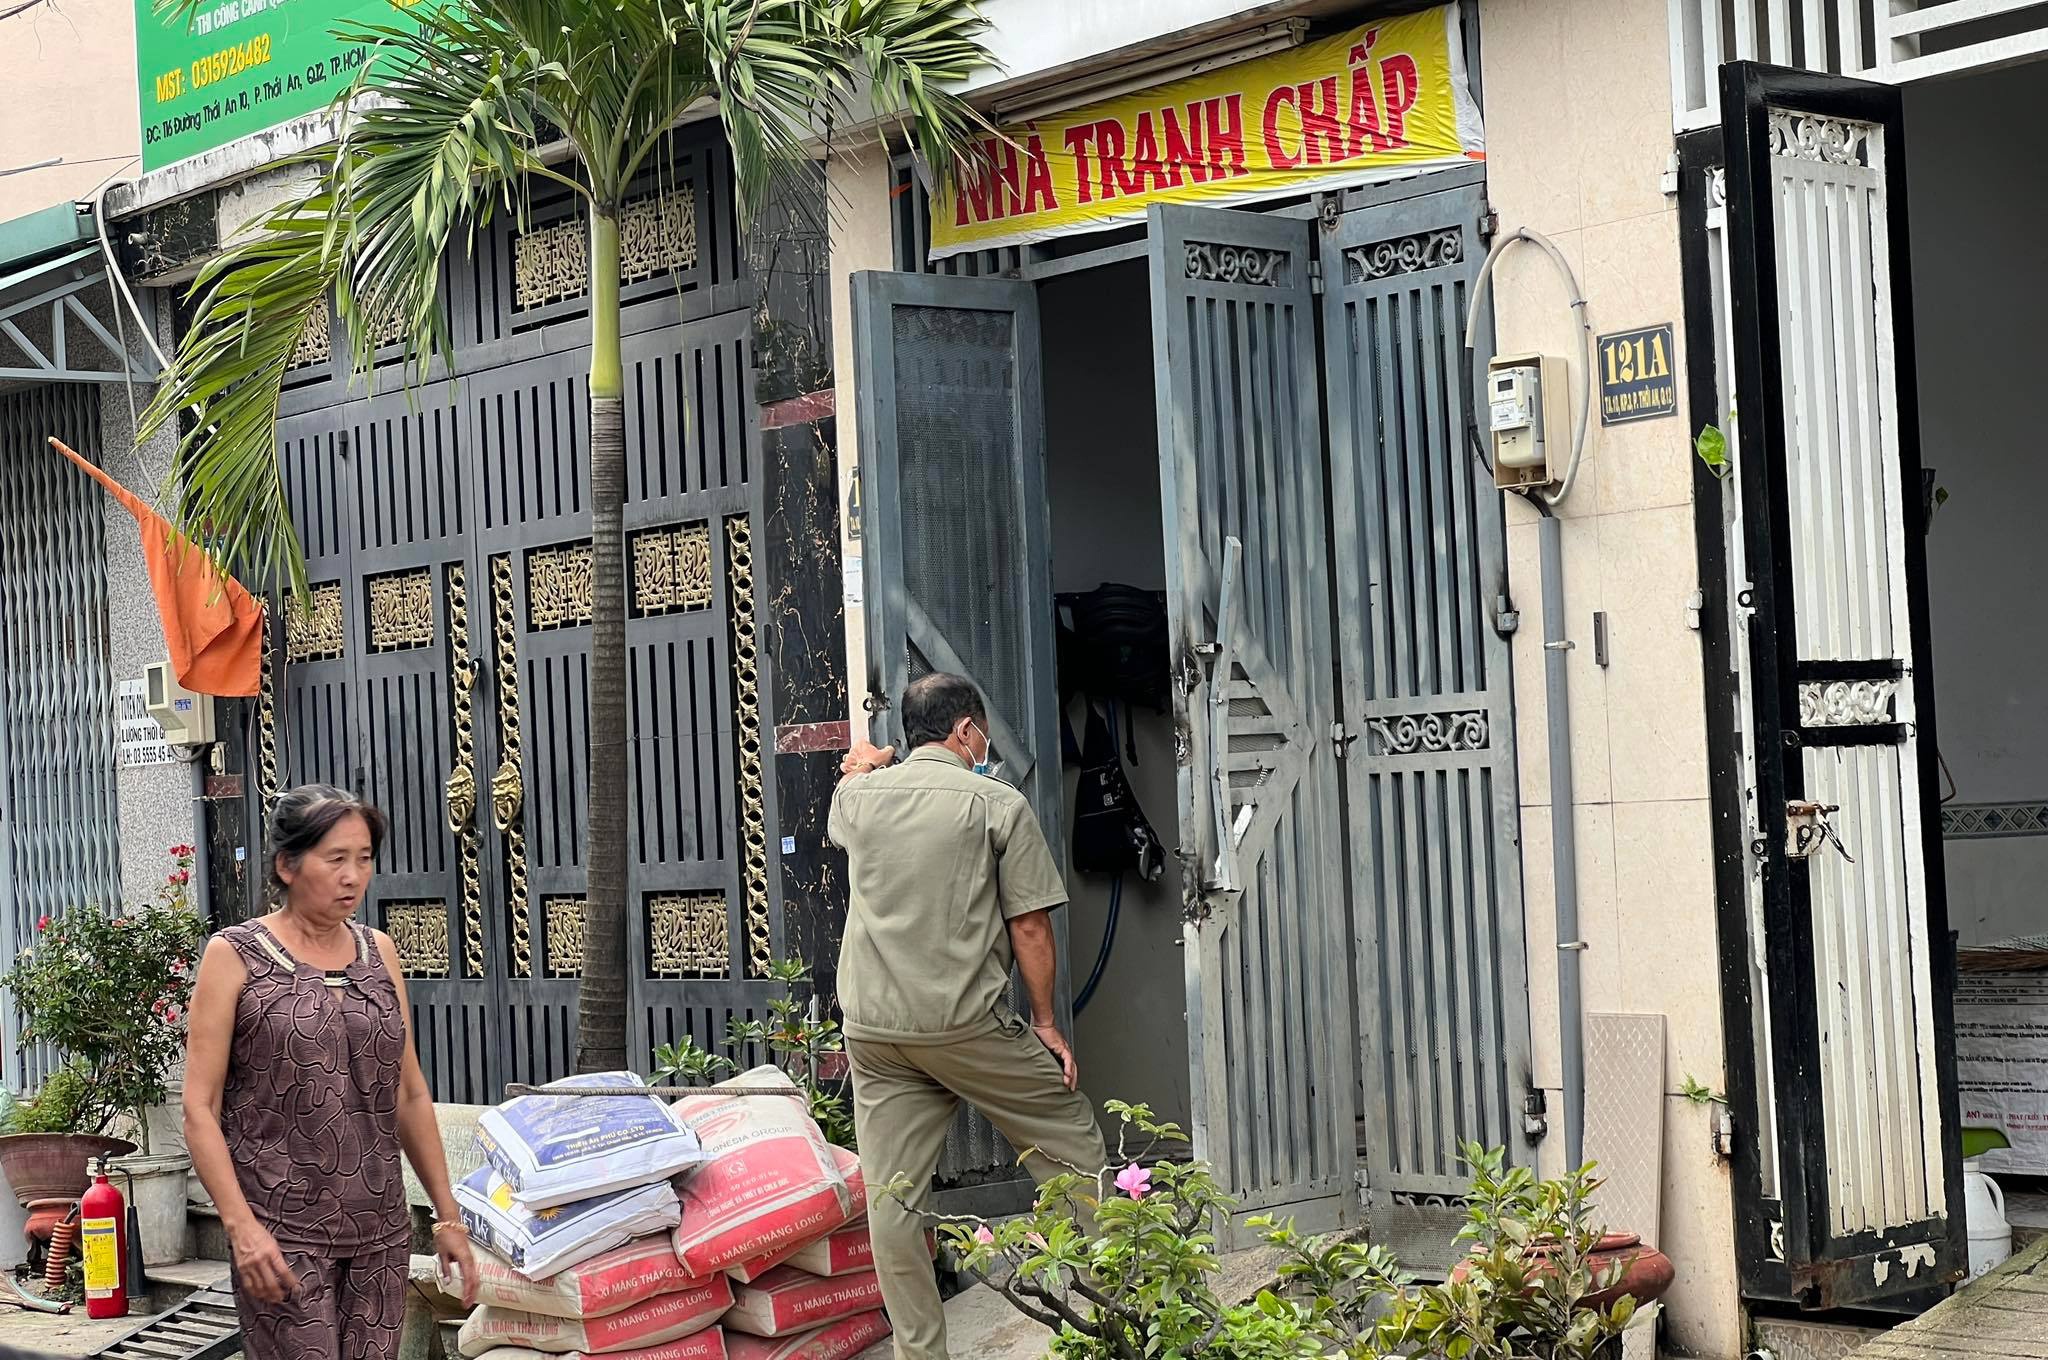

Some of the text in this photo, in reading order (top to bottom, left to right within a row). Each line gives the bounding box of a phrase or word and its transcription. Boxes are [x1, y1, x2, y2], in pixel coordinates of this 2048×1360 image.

[195, 14, 212, 36] THI
[213, 0, 239, 30] CÔNG
[156, 32, 272, 103] MST: 0315926482
[225, 97, 237, 116] An
[955, 28, 1420, 227] NHÀ TRANH CHẤP
[1604, 332, 1669, 385] 121A
[143, 746, 157, 763] 5555
[751, 1126, 793, 1138] GROUP
[795, 1211, 824, 1231] LONG
[606, 1322, 617, 1333] XI
[686, 1289, 713, 1306] LONG
[793, 1303, 803, 1314] XI
[848, 1323, 873, 1344] LONG
[682, 1344, 708, 1357] LONG
